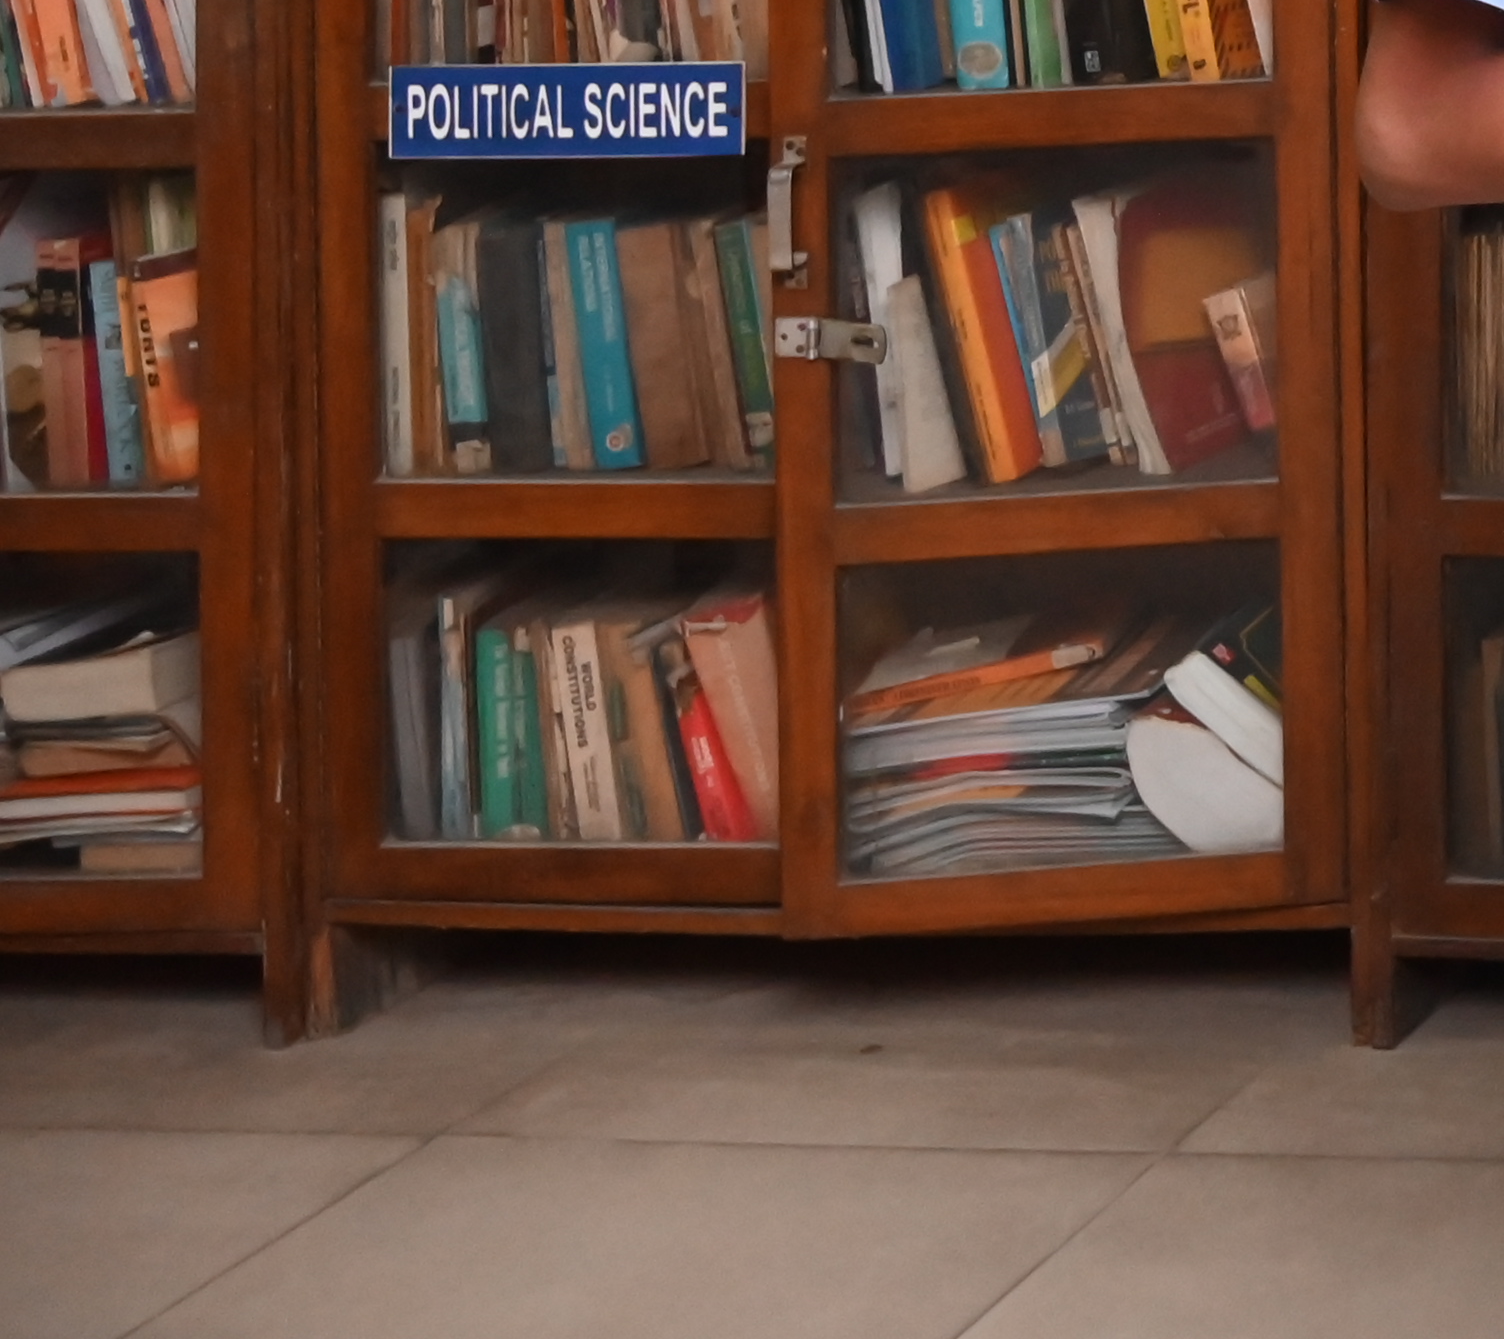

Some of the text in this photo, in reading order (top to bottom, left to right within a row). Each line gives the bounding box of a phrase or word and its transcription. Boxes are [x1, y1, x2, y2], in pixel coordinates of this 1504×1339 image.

[406, 82, 729, 139] POLITICAL SCIENCE
[561, 634, 591, 749] CONSTITUTIONS
